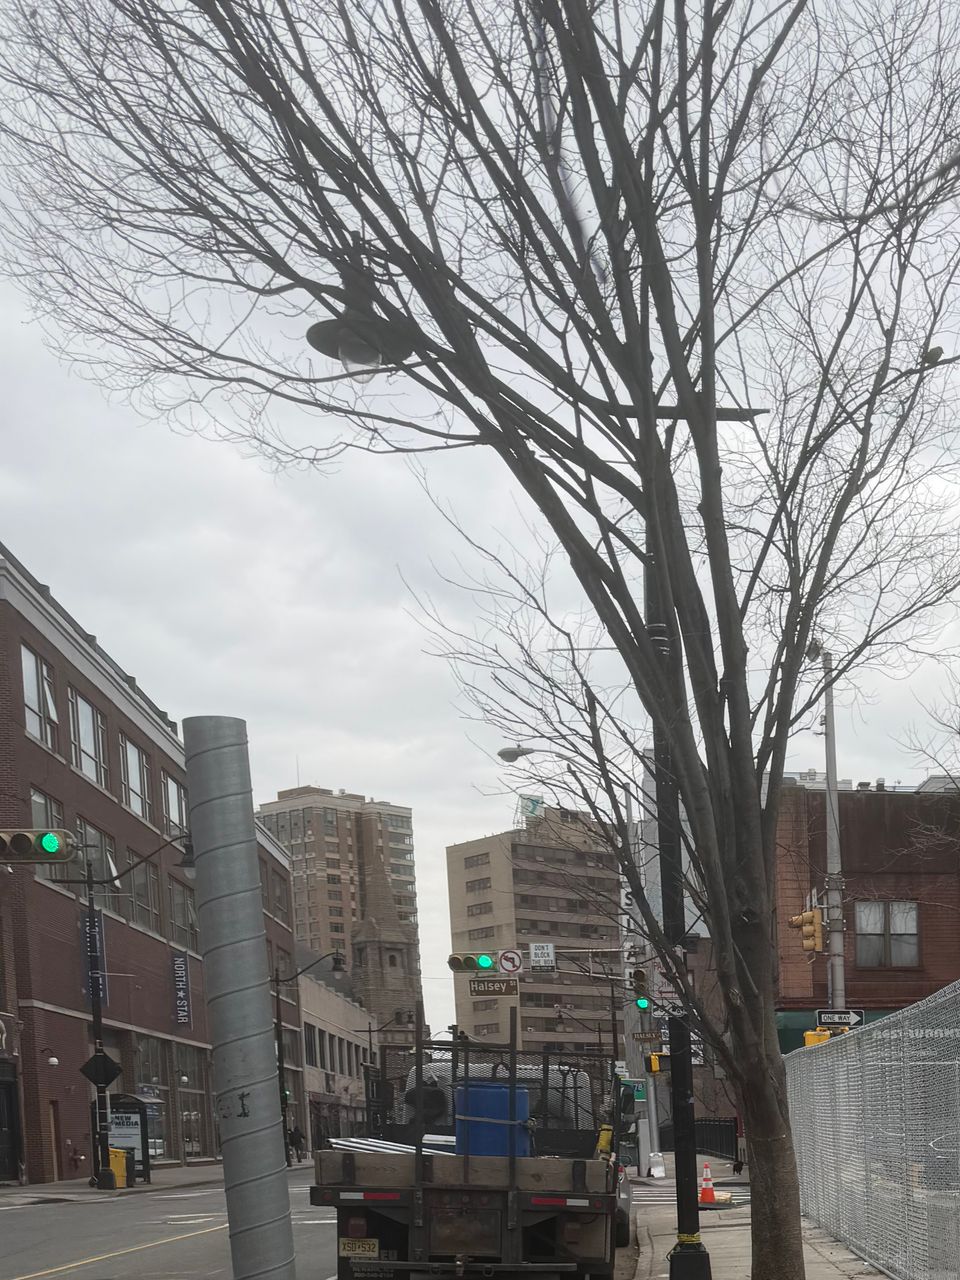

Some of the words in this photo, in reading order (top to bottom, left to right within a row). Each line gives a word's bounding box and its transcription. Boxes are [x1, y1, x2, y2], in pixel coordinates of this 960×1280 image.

[174, 957, 186, 989] NORTH
[470, 981, 507, 992] Halsey
[176, 1000, 189, 1023] STAR
[823, 1013, 836, 1021] ONE
[837, 1013, 850, 1021] WAY
